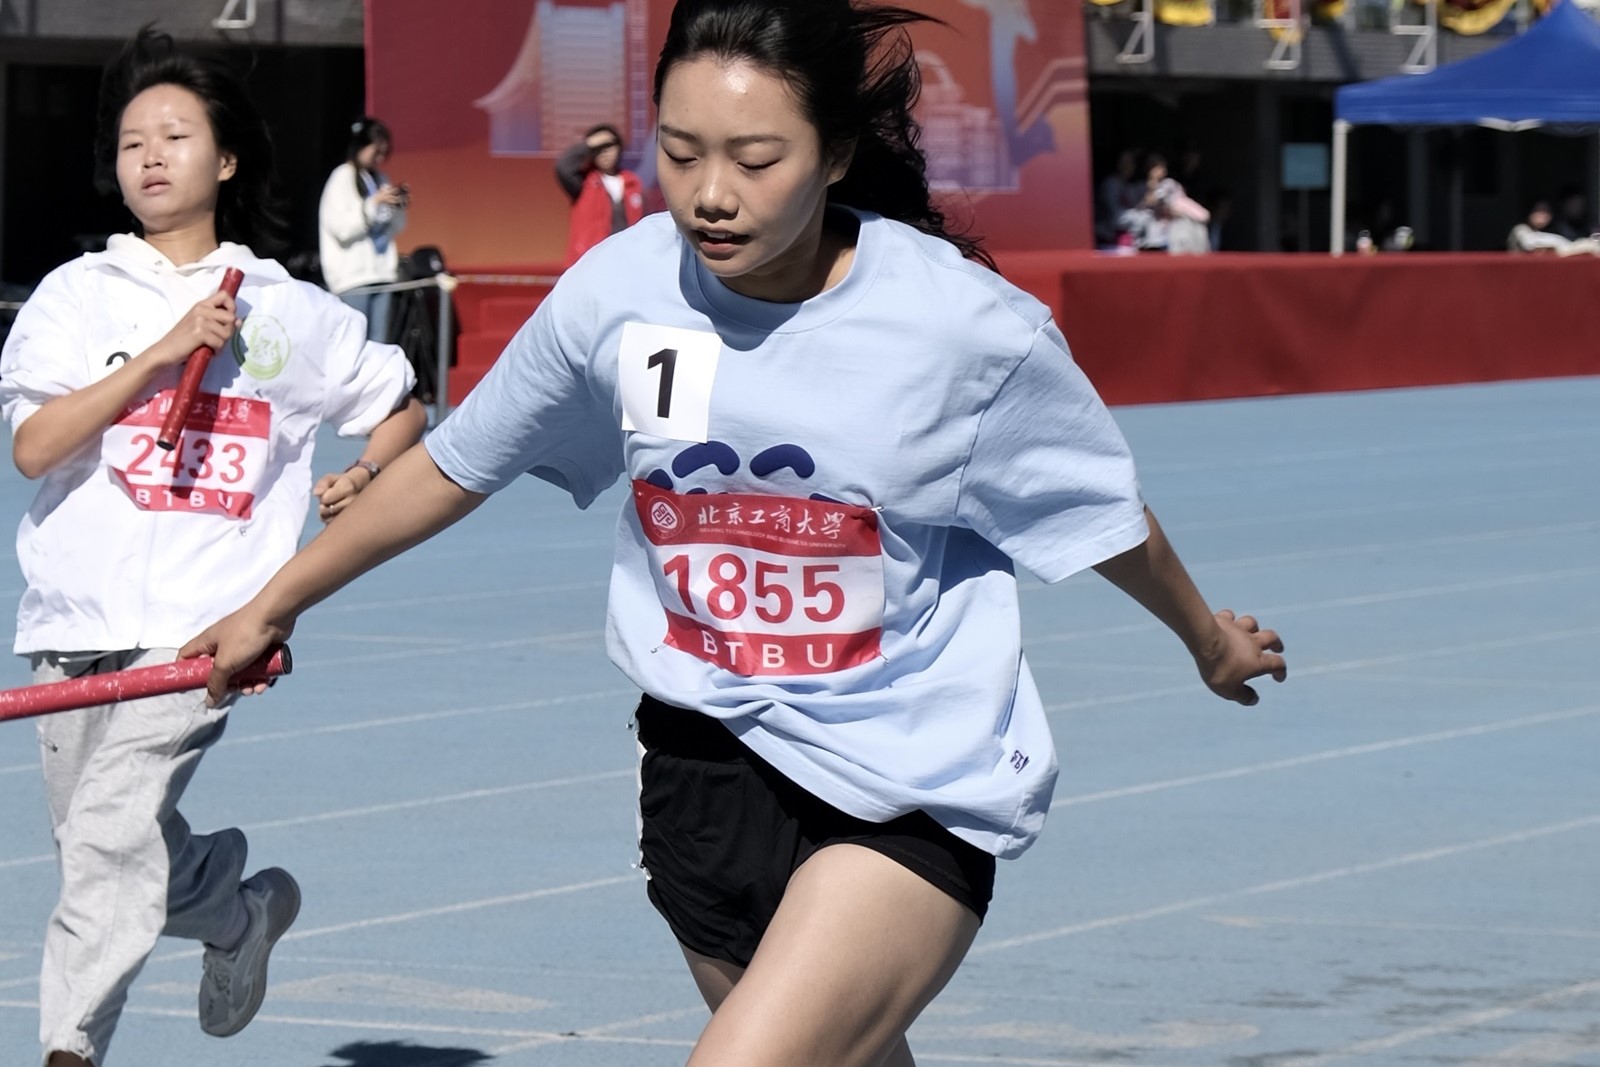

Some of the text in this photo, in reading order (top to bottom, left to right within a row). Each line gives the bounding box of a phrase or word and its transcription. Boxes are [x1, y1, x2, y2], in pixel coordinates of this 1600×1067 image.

[647, 348, 678, 419] 1
[125, 433, 247, 484] 2433
[725, 528, 766, 538] TECHNOLOGY
[766, 533, 777, 541] AND
[663, 552, 845, 624] 1855
